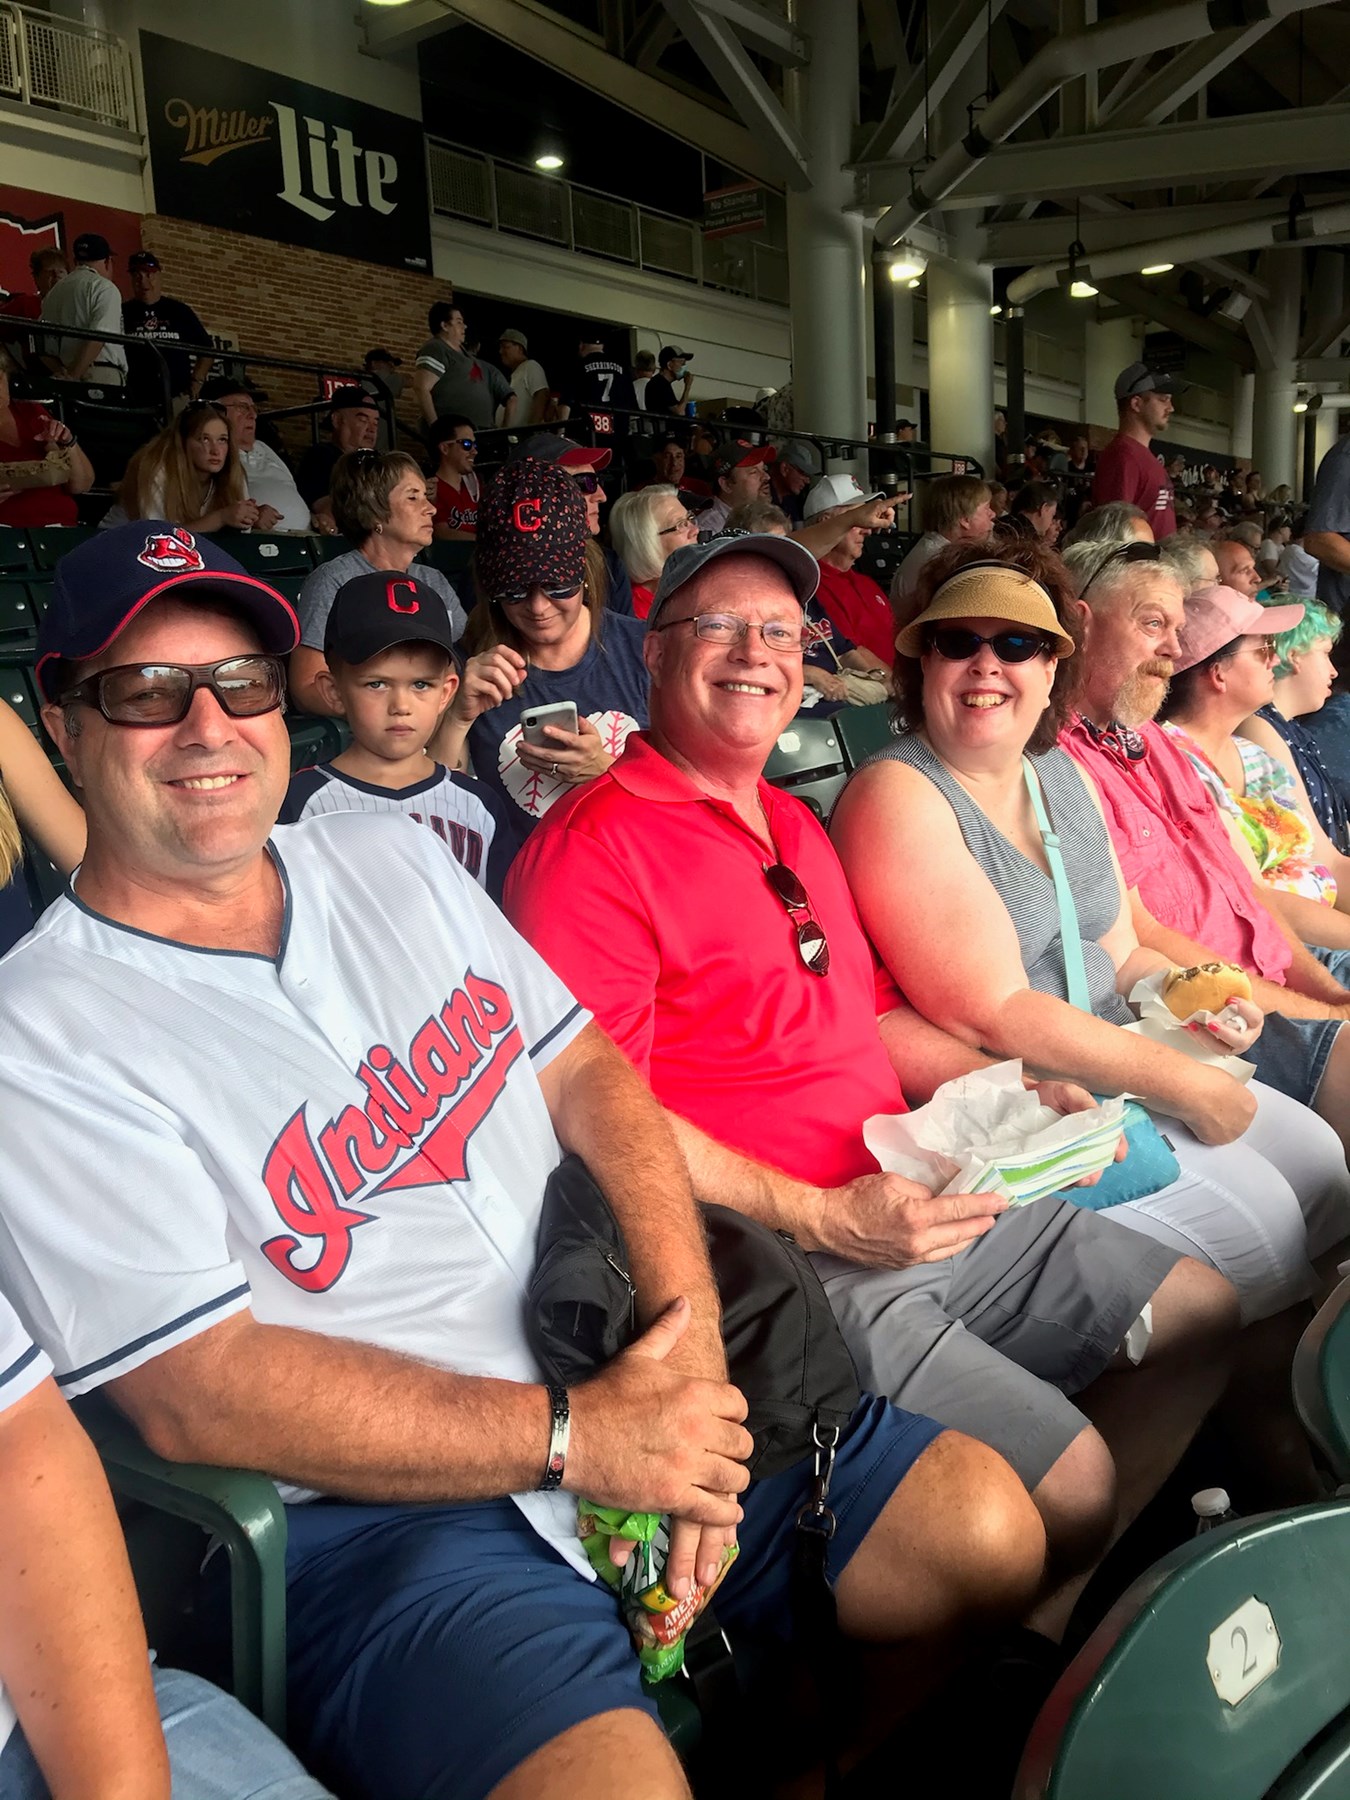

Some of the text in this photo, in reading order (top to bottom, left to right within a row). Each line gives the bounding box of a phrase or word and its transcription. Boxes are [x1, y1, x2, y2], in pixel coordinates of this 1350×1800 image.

[164, 98, 398, 222] Miller Lite
[597, 373, 614, 402] 7
[590, 414, 610, 432] 38
[513, 498, 542, 533] C
[386, 579, 420, 615] C
[261, 966, 514, 1293] Indians
[666, 1599, 700, 1640] IN-SHELL
[1231, 1626, 1257, 1679] 2
